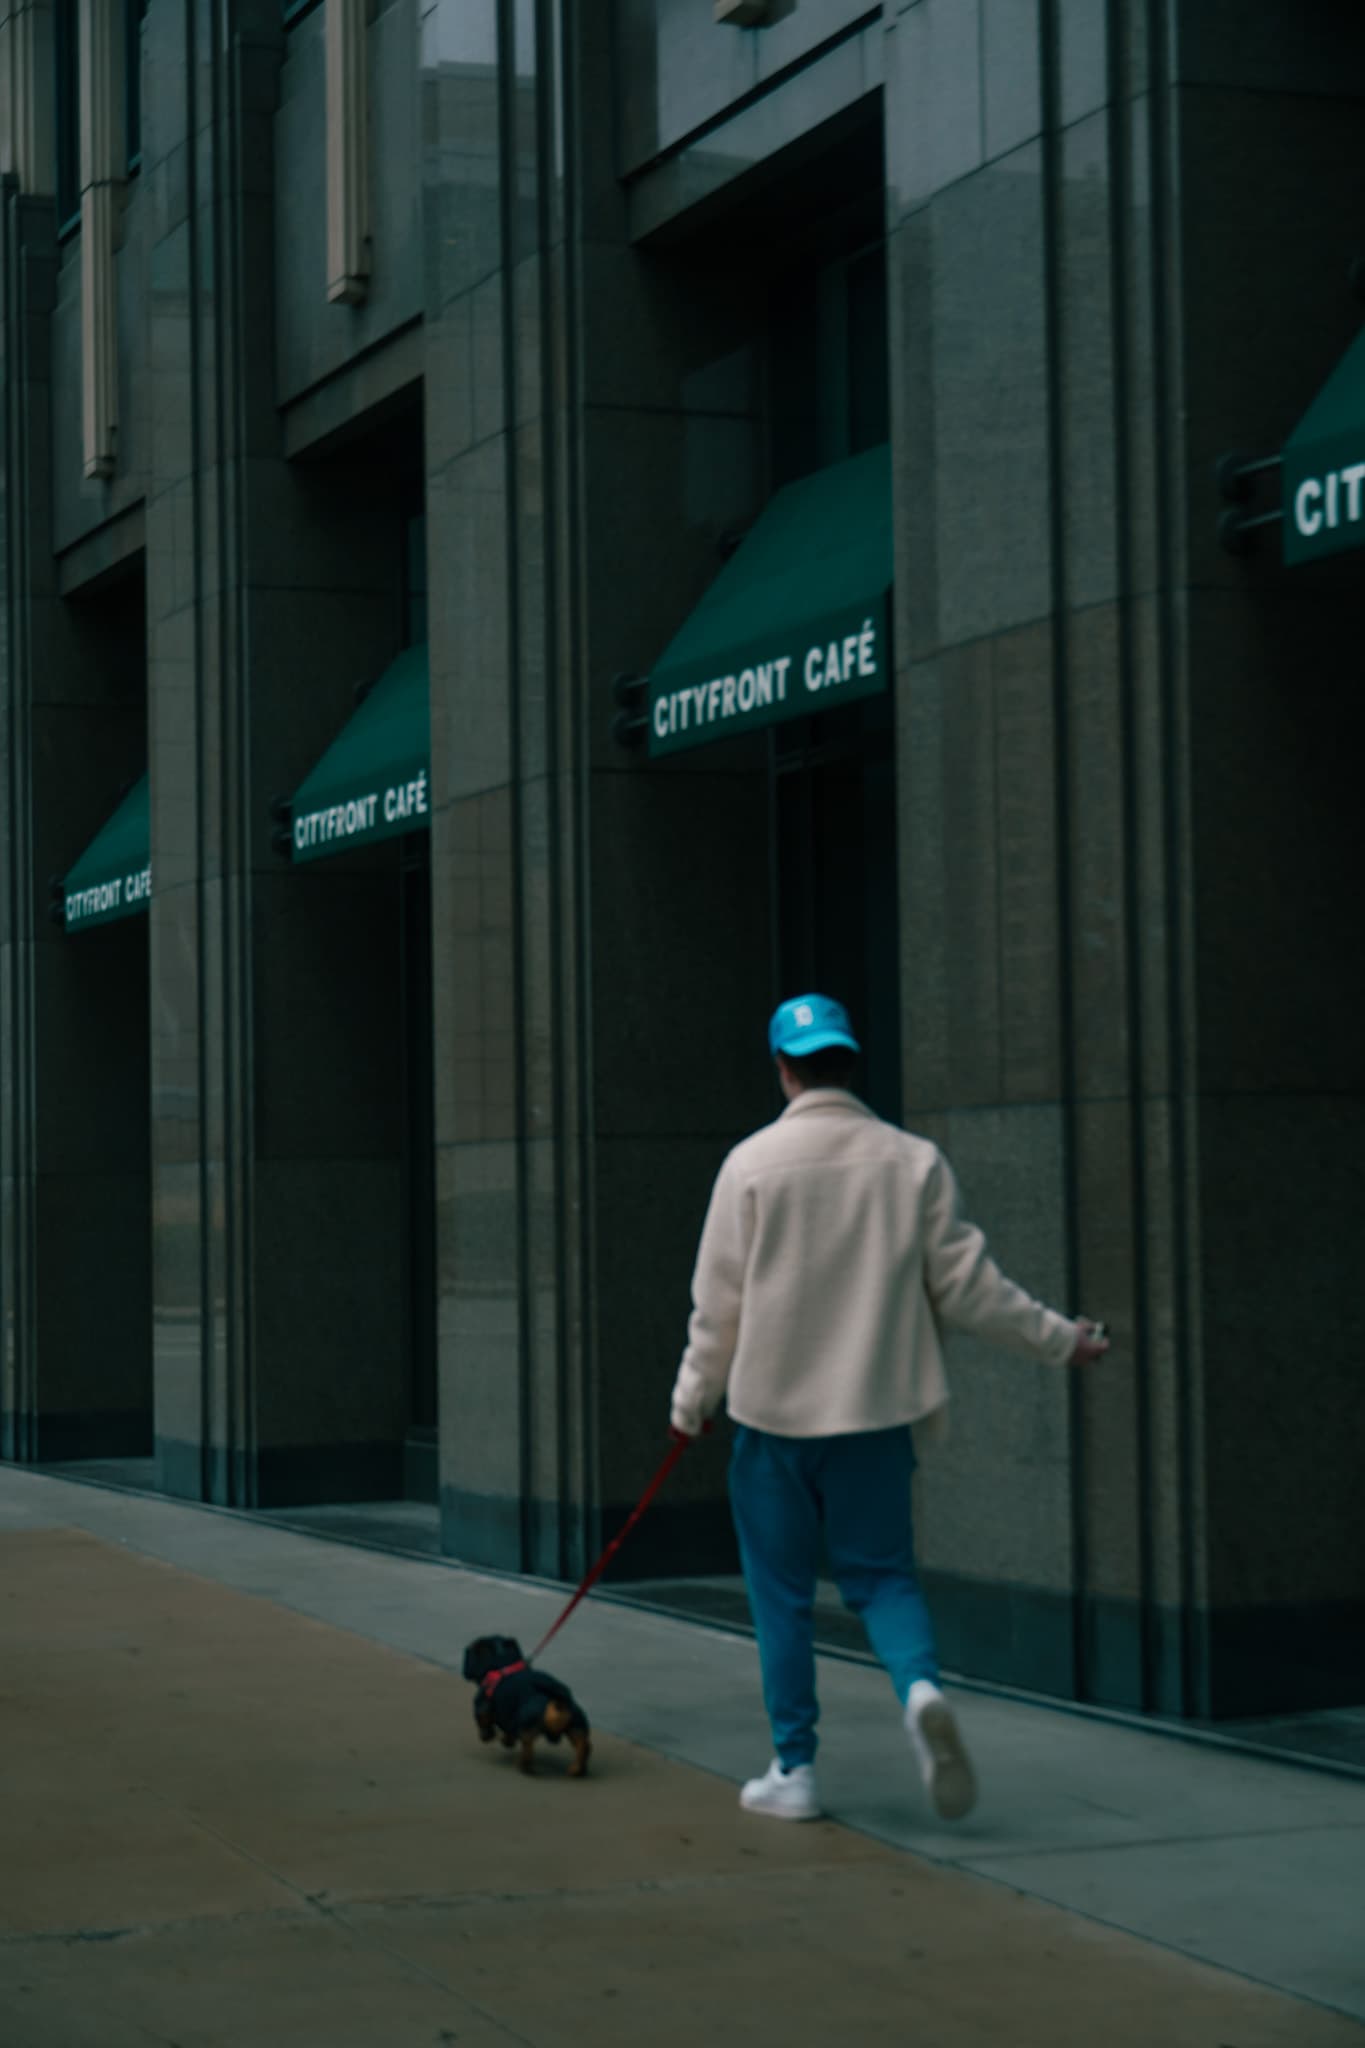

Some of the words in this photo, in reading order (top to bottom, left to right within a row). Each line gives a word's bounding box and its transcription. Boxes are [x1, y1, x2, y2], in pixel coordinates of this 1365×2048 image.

[1295, 463, 1365, 536] CIT
[654, 656, 791, 737] CITYFRONT
[804, 618, 876, 691] CAFÉ
[295, 793, 378, 849] CITYFRONT
[384, 768, 427, 822] CAFÉ
